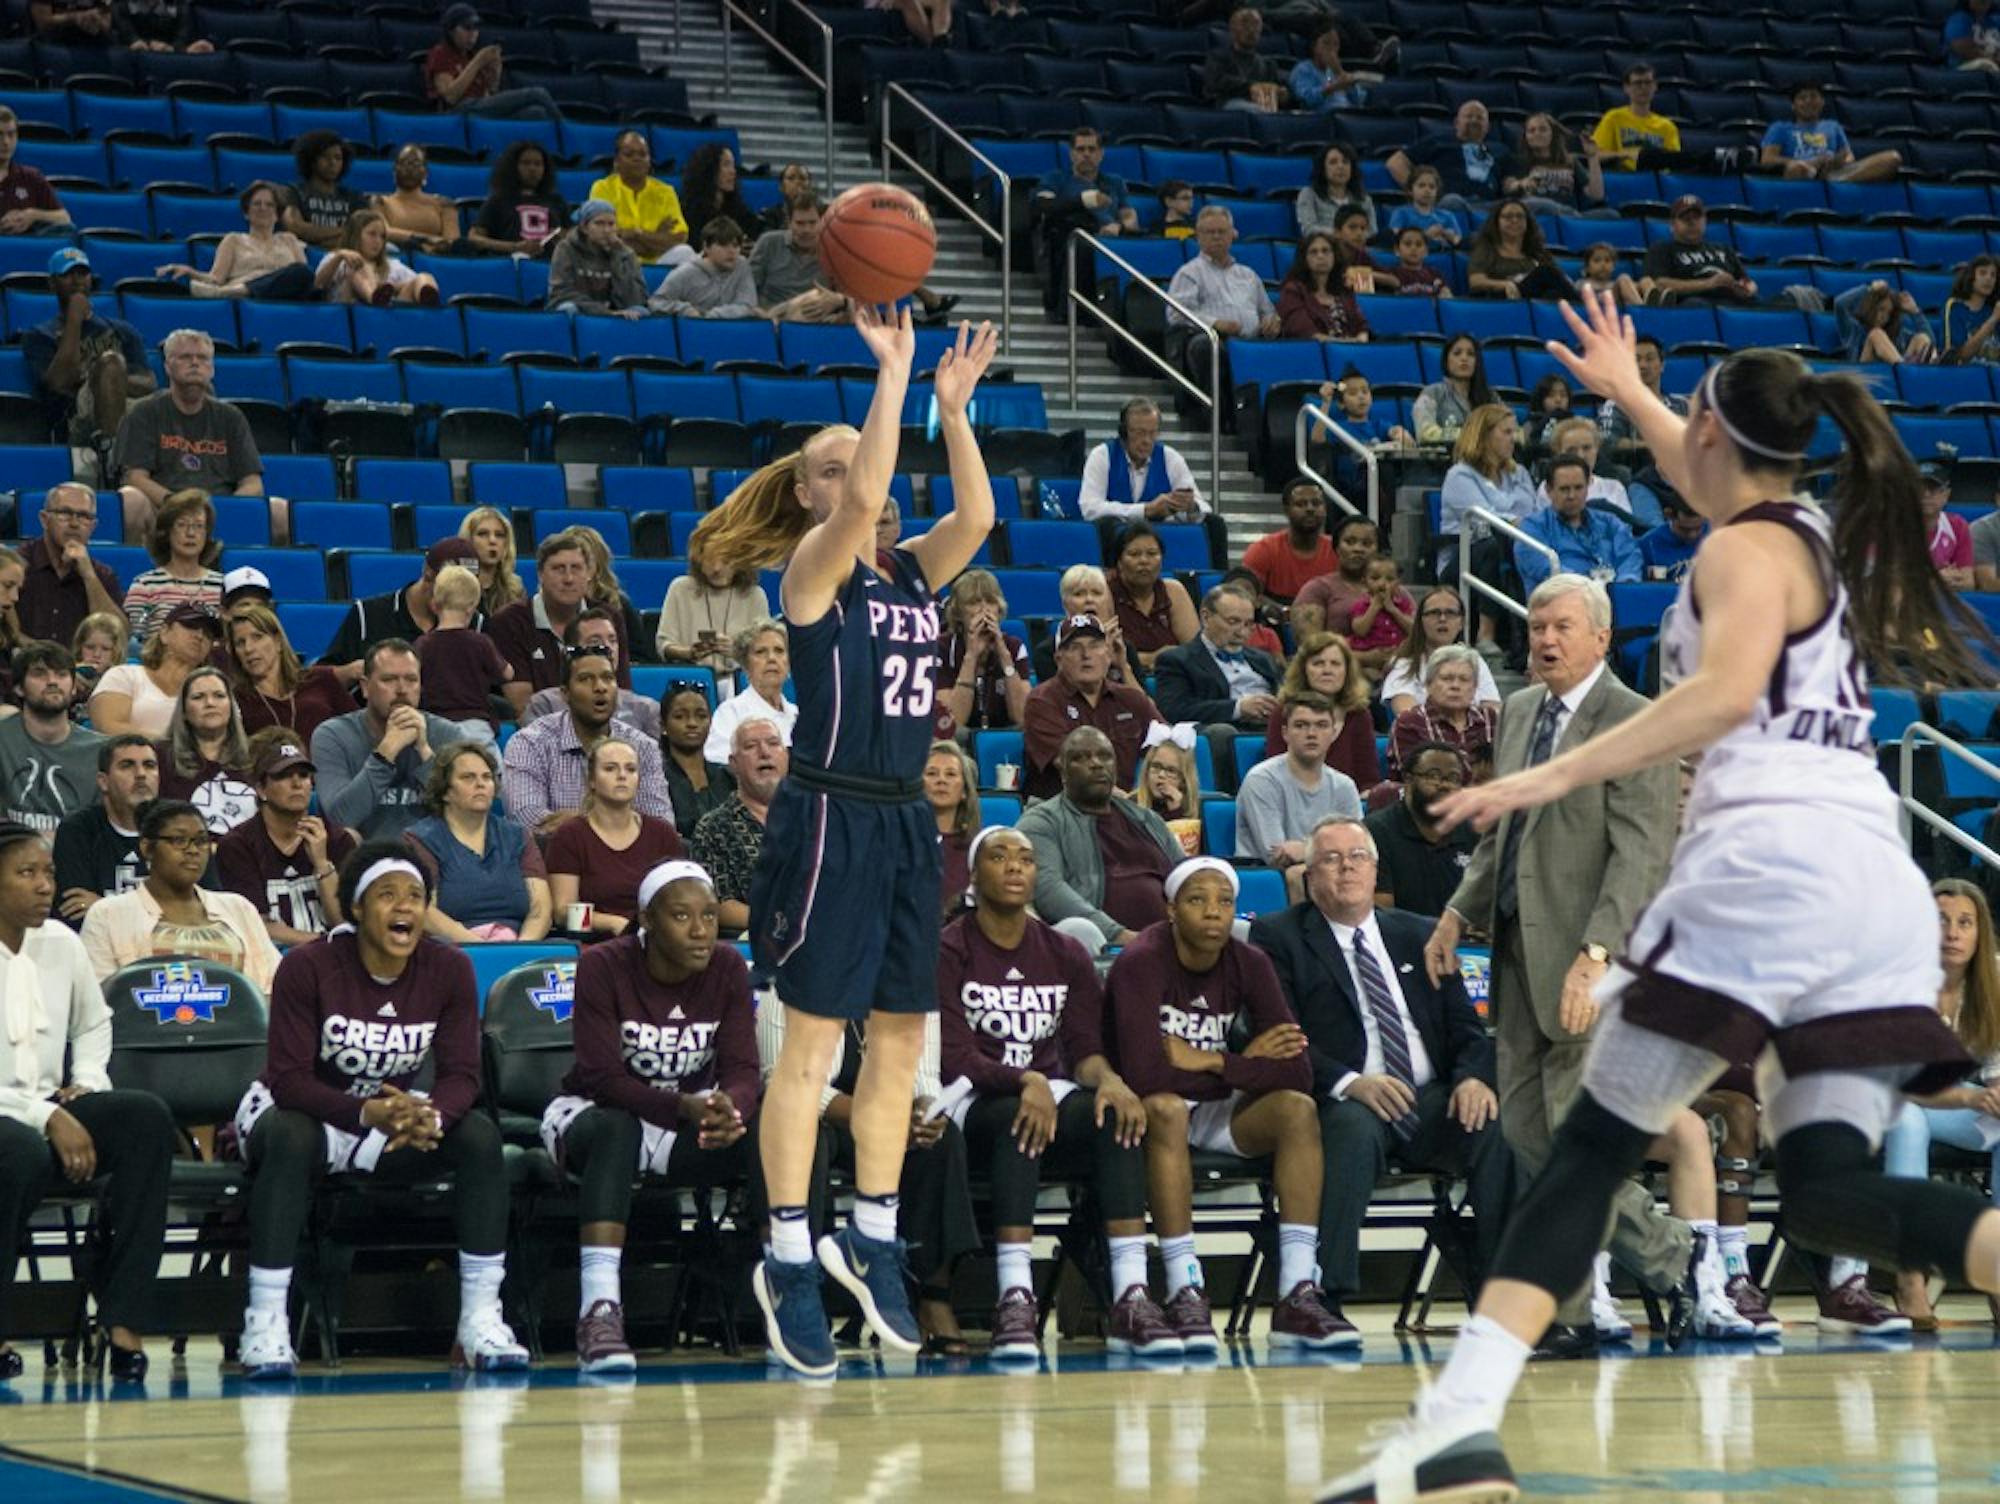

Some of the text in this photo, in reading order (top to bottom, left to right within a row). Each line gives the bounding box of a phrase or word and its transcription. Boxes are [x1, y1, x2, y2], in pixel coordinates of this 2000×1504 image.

[160, 434, 226, 455] BRONCOS
[883, 654, 934, 717] 25
[961, 981, 1068, 1012] CREATE
[323, 1014, 438, 1053] CREATE
[620, 1020, 720, 1053] CREAT
